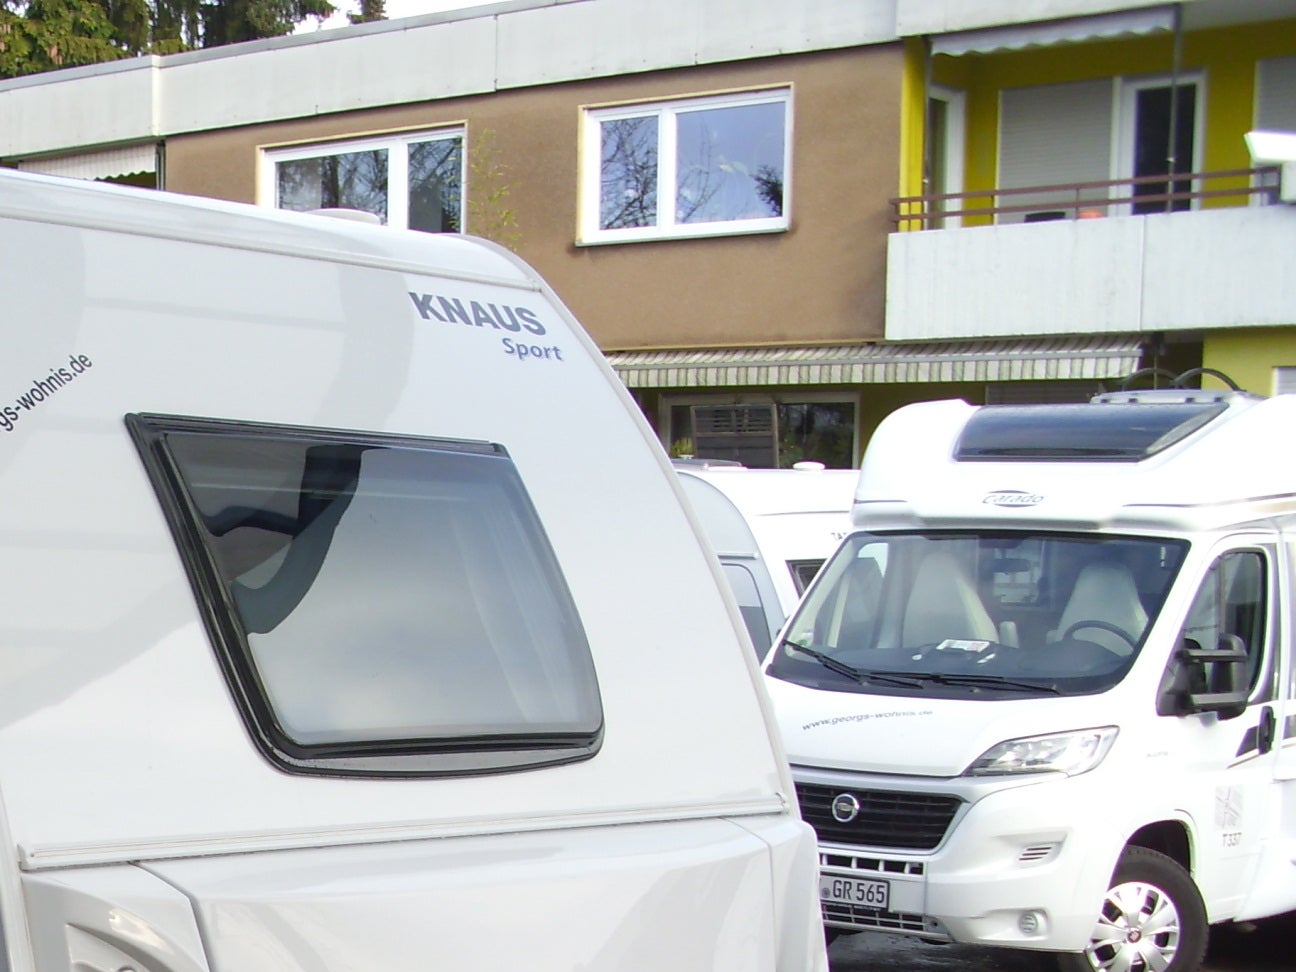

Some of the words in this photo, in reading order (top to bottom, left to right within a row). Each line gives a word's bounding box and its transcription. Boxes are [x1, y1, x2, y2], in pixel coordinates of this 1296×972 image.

[408, 291, 546, 336] KNAUS
[502, 337, 563, 361] Sport
[832, 879, 853, 900] GR
[855, 882, 886, 904] 565
